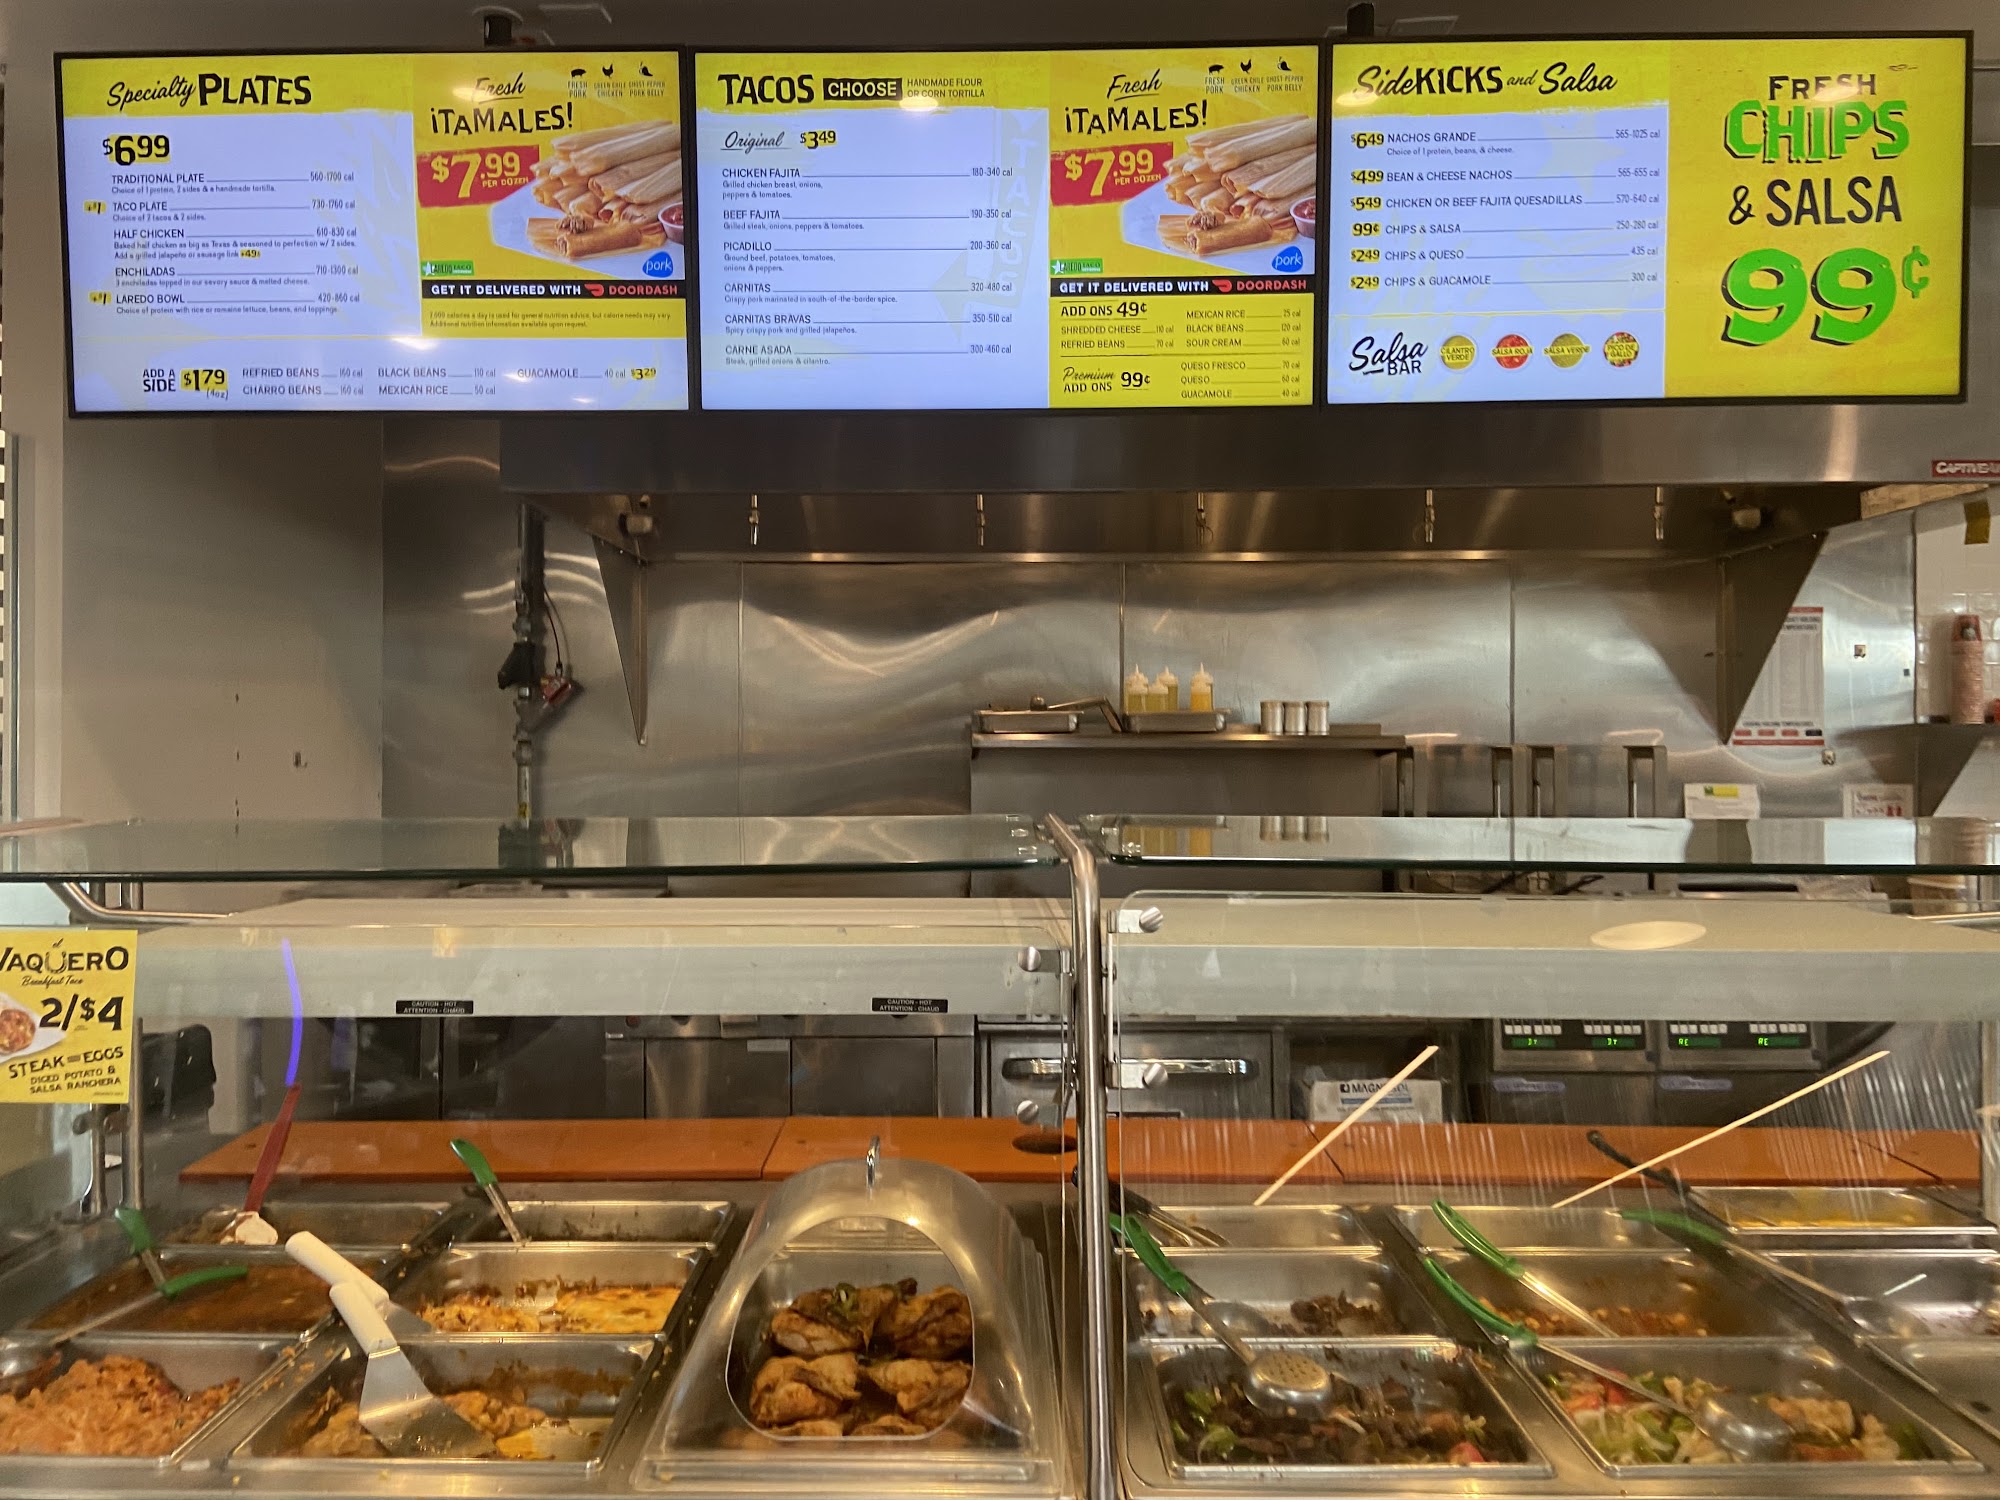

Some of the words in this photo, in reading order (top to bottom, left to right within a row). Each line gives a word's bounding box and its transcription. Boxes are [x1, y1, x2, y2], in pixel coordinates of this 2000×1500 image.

[907, 78, 954, 87] HANDMADE
[955, 78, 982, 87] FLOUR
[1107, 68, 1162, 99] Fresh
[1205, 77, 1225, 85] FRESH
[1506, 70, 1539, 87] and
[1538, 62, 1618, 95] Salsa
[474, 71, 526, 99] Fresh
[718, 74, 815, 105] TACOS
[827, 80, 897, 97] CHOOSE
[1206, 85, 1224, 94] PORK
[1768, 73, 1877, 100] FRESH
[107, 76, 195, 111] Specialty
[199, 73, 312, 106] PLATES
[907, 89, 919, 98] OR
[921, 89, 946, 98] CORN
[948, 89, 985, 98] TORTILLA
[1387, 133, 1430, 143] NACHOS
[1433, 132, 1476, 142] GRANDE
[1615, 129, 1648, 139] 565-1025
[1649, 130, 1660, 138] cal
[1723, 100, 1910, 164] CHIPS
[724, 131, 784, 154] Original
[112, 174, 174, 184] TRADITIONAL
[176, 173, 205, 183] PLATE
[310, 172, 342, 182] 560-1700
[343, 172, 354, 181] cal
[430, 151, 520, 198] $7.99
[722, 168, 767, 178] CHICKEN
[769, 168, 800, 178] FAJITA
[972, 167, 1000, 177] 180-340
[1002, 167, 1013, 177] cal
[1064, 149, 1154, 197] $7.99
[1386, 172, 1414, 182] BEAN
[1416, 172, 1424, 181] &
[1426, 171, 1466, 181] CHEESE
[1469, 170, 1513, 180] NACHOS
[1617, 167, 1647, 177] 565-655
[1649, 168, 1660, 177] cal
[746, 180, 773, 188] chicken
[774, 180, 797, 189] breast,
[798, 181, 823, 189] onions,
[1115, 177, 1131, 186] PER
[1134, 174, 1161, 184] DOZEN
[113, 202, 137, 211] TACO
[139, 202, 168, 211] PLATE
[1386, 198, 1432, 208] CHICKEN
[1435, 198, 1450, 207] OR
[1452, 197, 1478, 207] BEEF
[1480, 196, 1512, 206] FAJITA
[1515, 195, 1582, 206] QUESADILLAS
[1728, 185, 1756, 225] &
[1766, 176, 1902, 226] SALSA
[723, 210, 748, 219] BEEF
[750, 210, 780, 219] FAJITA
[971, 209, 999, 218] 190-350
[1001, 209, 1012, 218] cal
[113, 230, 138, 239] HALF
[139, 229, 185, 239] CHICKEN
[1352, 223, 1380, 237] 99¢
[1385, 224, 1417, 234] CHIPS
[1419, 224, 1427, 234] &
[1429, 224, 1461, 234] SALSA
[723, 242, 772, 251] PICADILLO
[970, 241, 999, 250] 200-360
[1001, 241, 1012, 250] cal
[1275, 252, 1302, 269] pork
[1385, 251, 1416, 261] CHIPS
[1418, 250, 1426, 260] &
[1429, 250, 1464, 261] QUESO
[646, 257, 673, 274] pork
[115, 267, 175, 277] ENCHILADAS
[1059, 283, 1084, 293] GET
[1088, 282, 1099, 293] IT
[1104, 282, 1173, 293] DELIVERED
[1177, 281, 1209, 292] WITH
[1237, 280, 1306, 291] DOORDASH
[1384, 277, 1416, 287] CHIPS
[1418, 276, 1426, 286] &
[1429, 275, 1491, 285] GUACAMOLE
[431, 285, 455, 295] GET
[459, 285, 472, 295] IT
[476, 284, 545, 295] DELIVERED
[549, 284, 581, 295] WITH
[608, 284, 678, 295] DOORDASH
[724, 283, 771, 293] CARNITAS
[116, 294, 154, 304] LAREDO
[157, 294, 185, 303] BOWL
[1061, 306, 1086, 317] ADD
[1089, 305, 1113, 316] ONS
[1116, 301, 1147, 318] 49¢
[1186, 310, 1224, 319] MEXICAN
[1225, 310, 1245, 318] RICE
[725, 315, 771, 324] CARNITAS
[774, 315, 811, 324] BRAVAS
[1061, 326, 1106, 335] SHREDDED
[1107, 325, 1141, 334] CHEESE
[1186, 324, 1213, 333] BLACK
[1216, 324, 1244, 332] BEANS
[725, 345, 758, 354] CARNE
[760, 345, 792, 354] ASADA
[1349, 332, 1428, 371] Salsa
[1514, 347, 1533, 355] ROJA
[143, 368, 166, 378] ADD
[167, 368, 175, 378] A
[378, 368, 410, 377] BLACK
[414, 368, 446, 377] BEANS
[517, 368, 578, 378] GUACAMOLE
[1387, 360, 1422, 375] BAR
[1063, 367, 1114, 382] Premium
[143, 379, 176, 392] SIDE
[1063, 383, 1087, 393] ADD
[1091, 382, 1112, 392] ONS
[1121, 372, 1150, 388] 99¢
[206, 388, 229, 400] (4oz)
[379, 385, 423, 395] MEXICAN
[425, 385, 448, 395] RICE
[66, 975, 84, 985] Taco
[39, 994, 124, 1031] 2/$4
[9, 1055, 65, 1079] STEAK
[83, 1046, 124, 1064] EGGS
[30, 1074, 60, 1085] DICED
[64, 1069, 103, 1081] POTATO
[30, 1084, 62, 1094] SALSA
[67, 1078, 122, 1091] RANCHERA
